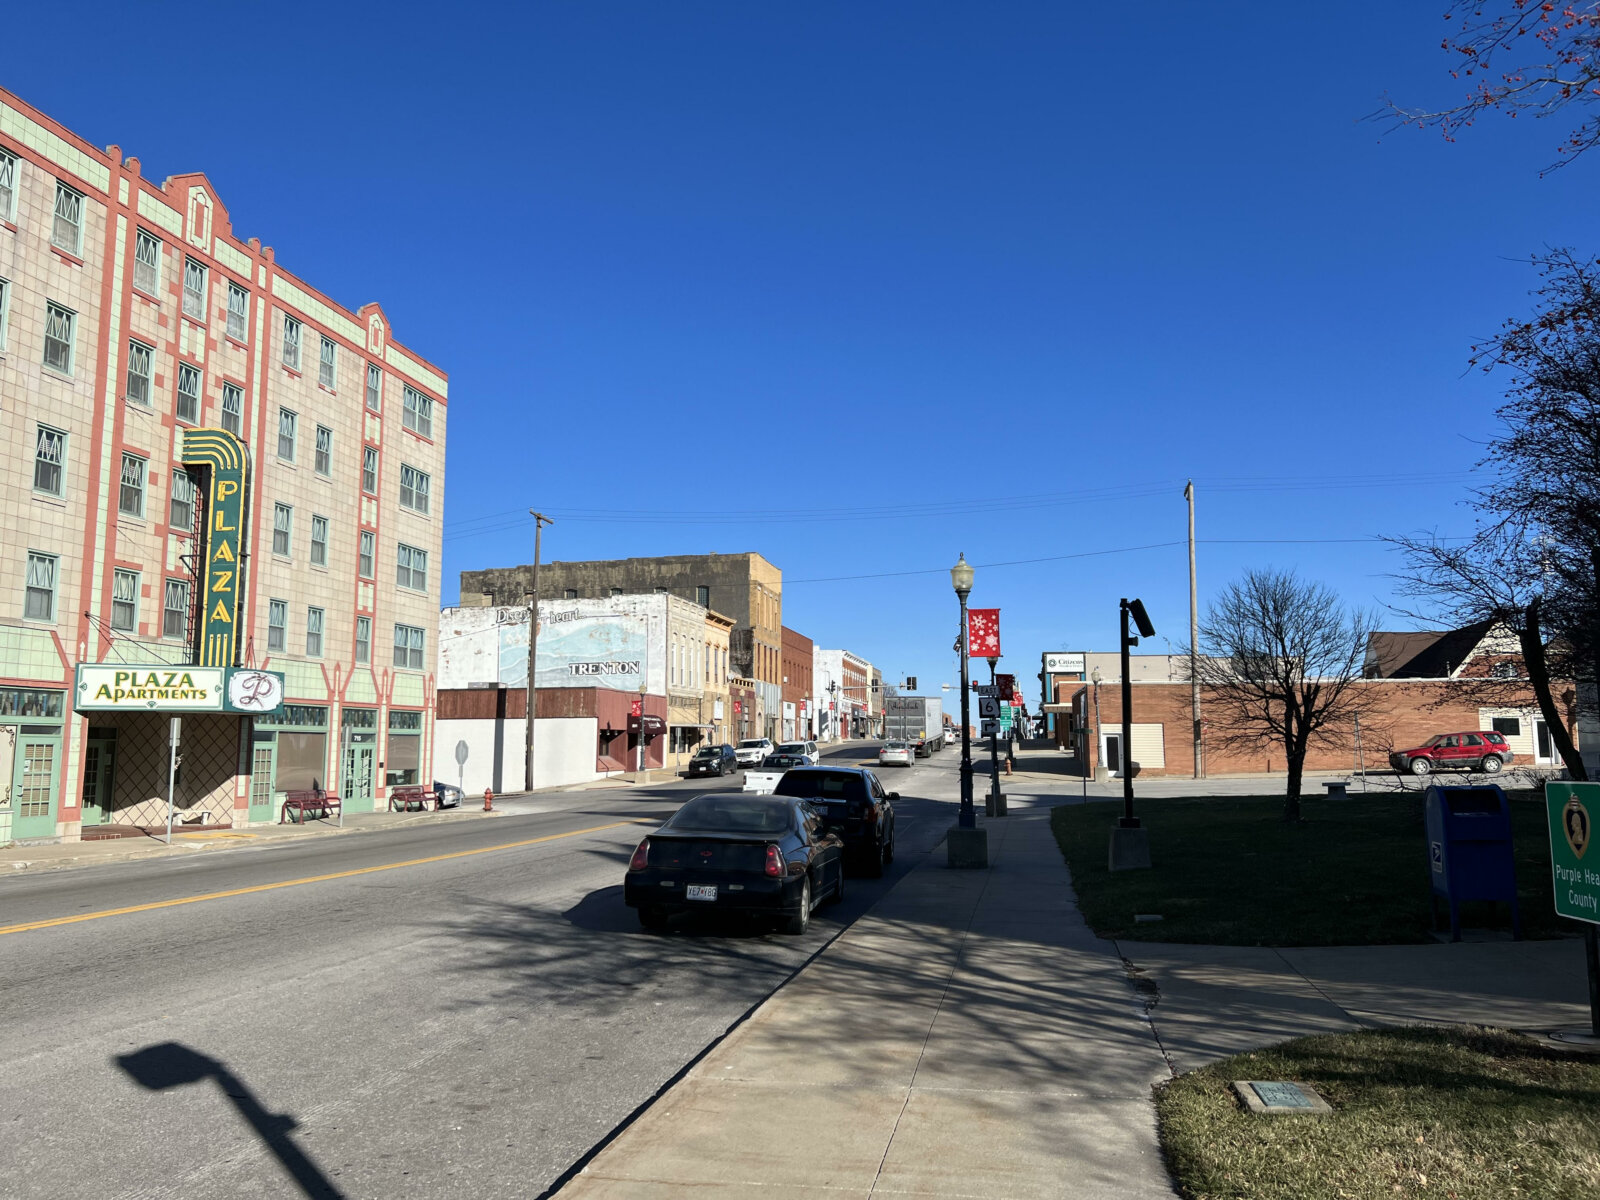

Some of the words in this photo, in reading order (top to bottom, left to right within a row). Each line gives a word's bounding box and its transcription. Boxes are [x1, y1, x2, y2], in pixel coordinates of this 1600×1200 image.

[209, 480, 238, 623] PLAZA
[568, 661, 640, 675] TRENTON
[115, 671, 195, 688] PLAZA
[980, 687, 996, 695] EAST
[985, 702, 993, 712] 6
[1556, 865, 1582, 886] Purple
[1569, 890, 1597, 913] County
